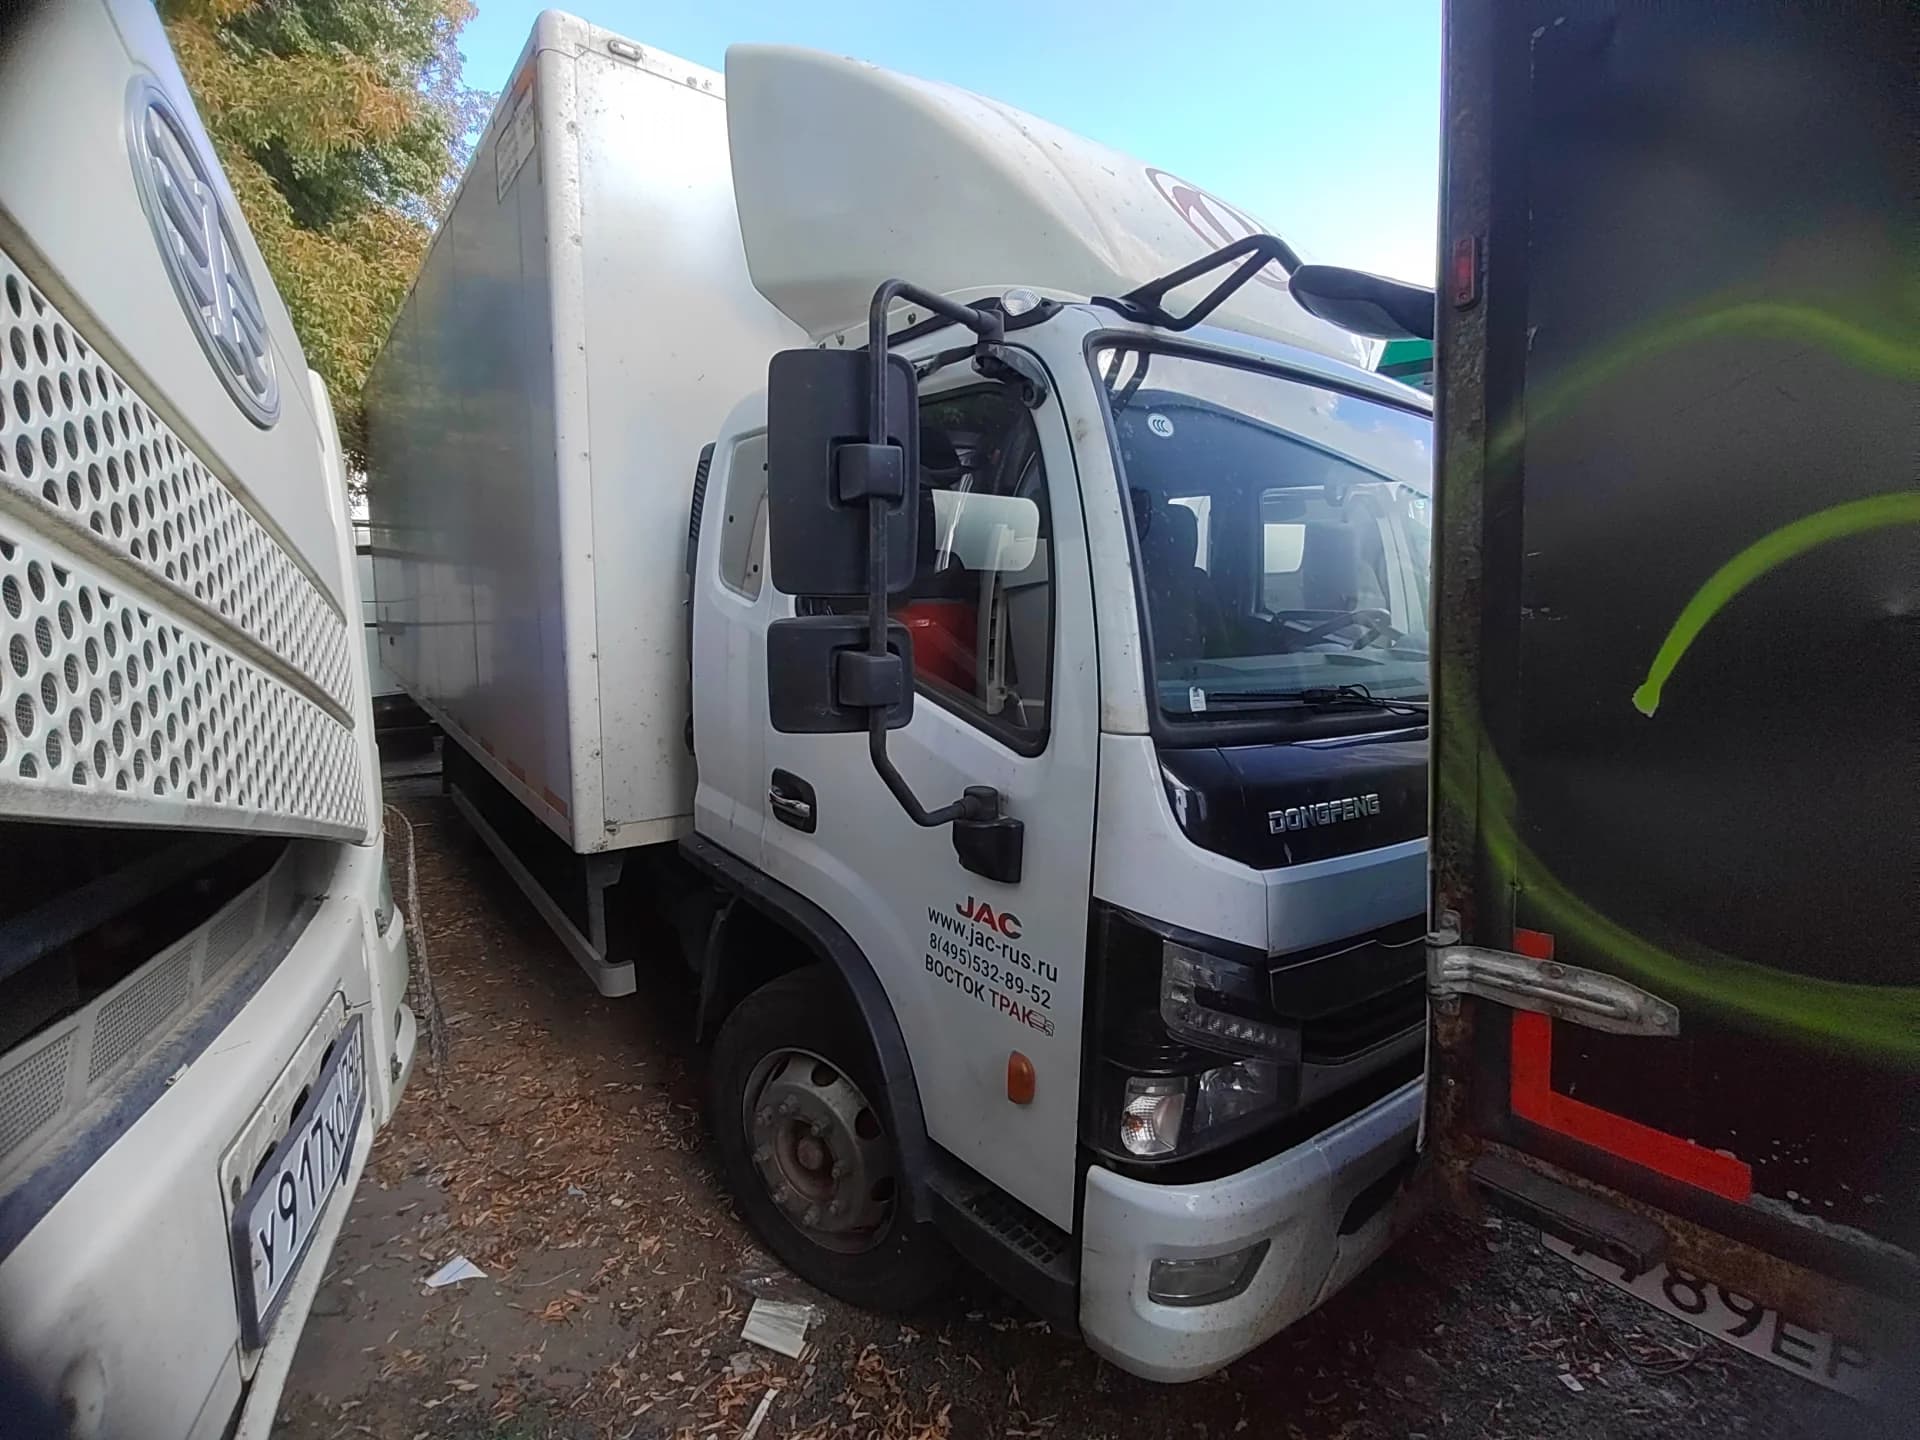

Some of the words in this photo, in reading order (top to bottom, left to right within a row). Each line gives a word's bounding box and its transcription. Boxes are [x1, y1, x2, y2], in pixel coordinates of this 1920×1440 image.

[1268, 793, 1380, 835] DONGFENG
[928, 906, 1058, 983] www.jac-rus.ru
[956, 896, 1022, 939] JAC
[925, 953, 985, 1002] ВОСТОК
[988, 988, 1034, 1029] ТРАК
[929, 932, 1051, 1010] 8(495)532-89-52
